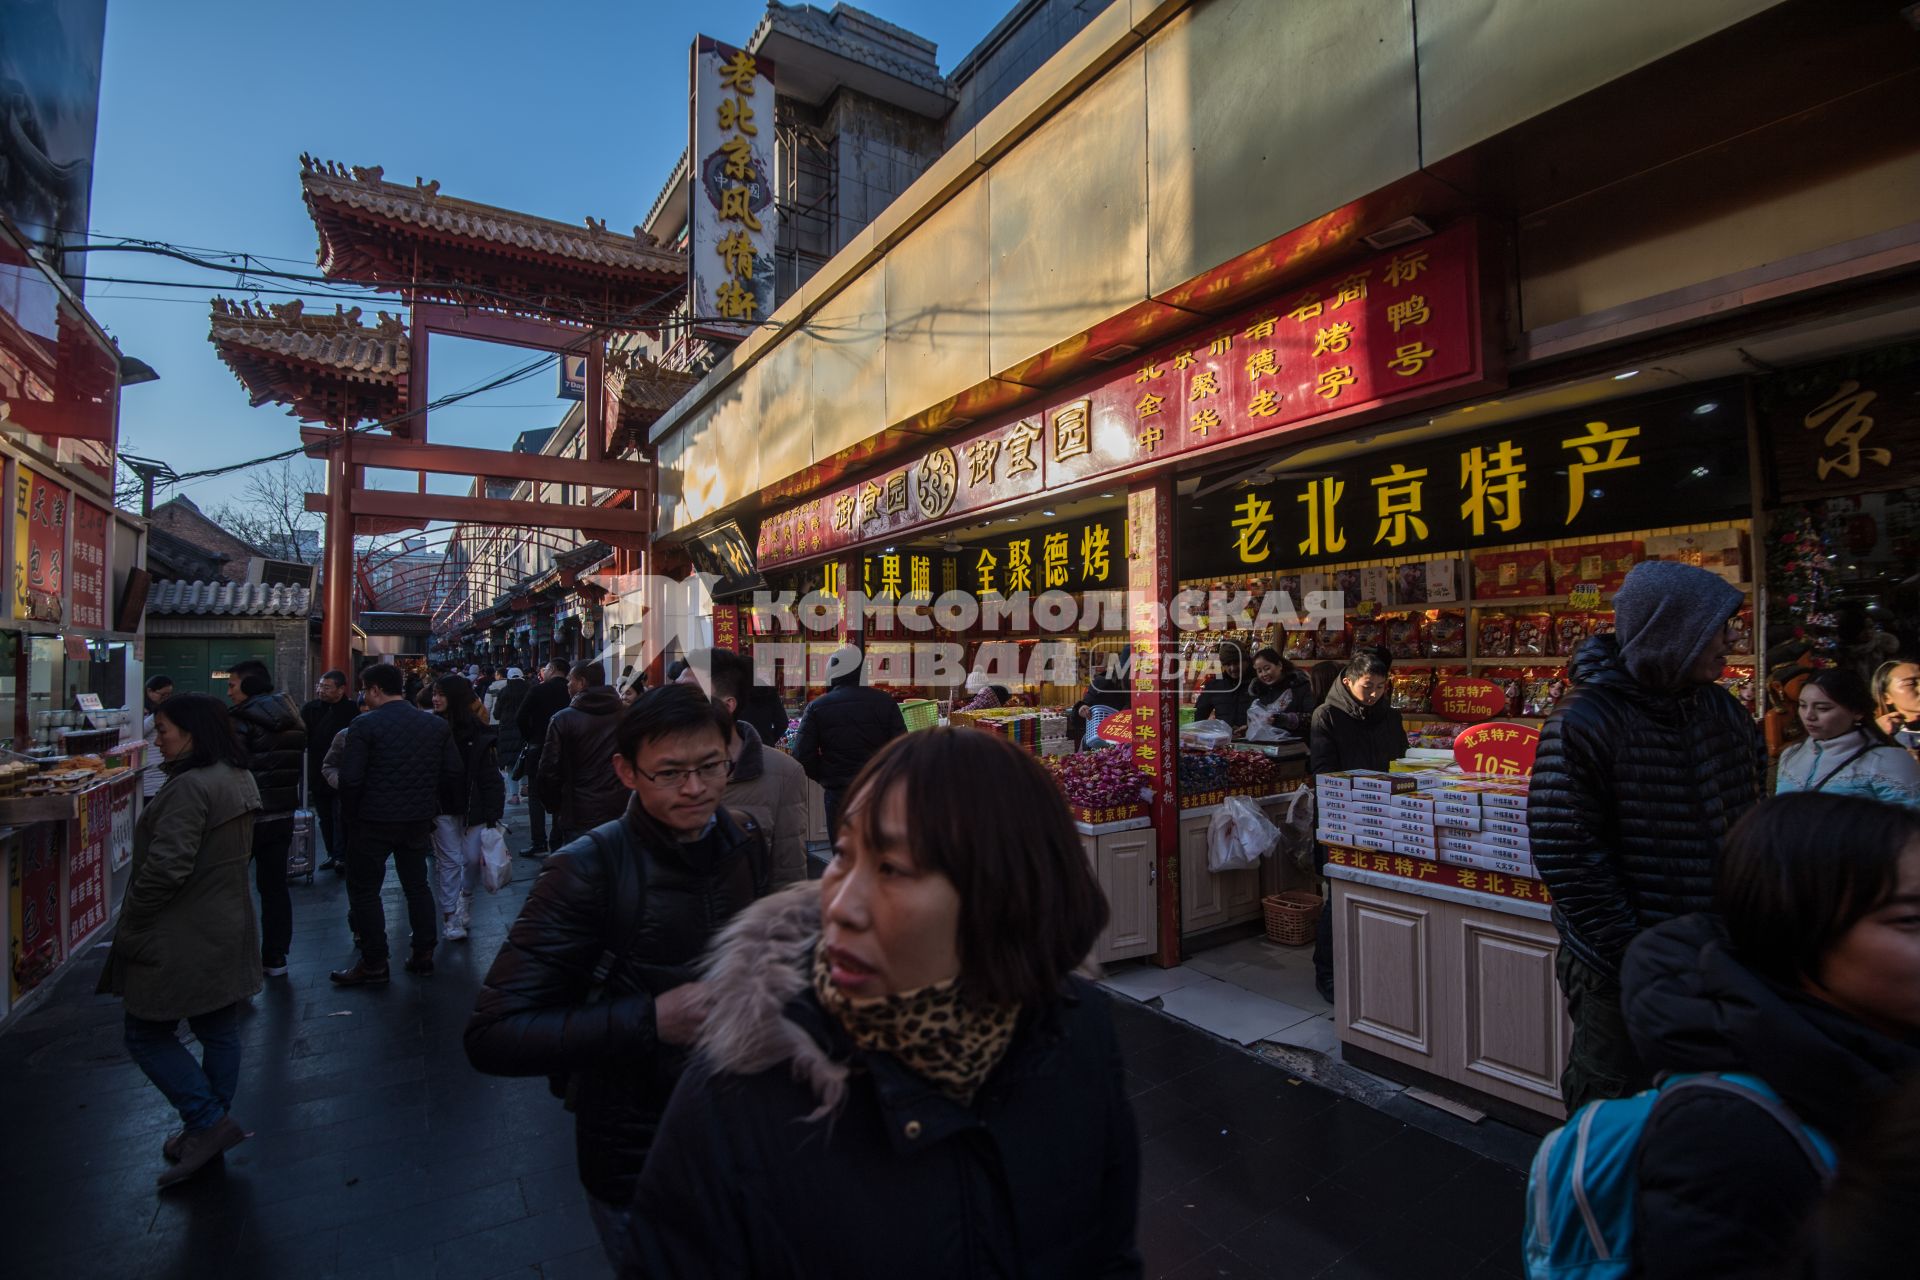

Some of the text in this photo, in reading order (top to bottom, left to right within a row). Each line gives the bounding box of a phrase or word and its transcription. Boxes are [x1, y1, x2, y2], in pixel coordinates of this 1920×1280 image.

[715, 51, 763, 327] 老北京风情街
[1136, 250, 1430, 384] 北京市著名商标
[1135, 294, 1432, 420] 全聚德烤鸭
[1138, 341, 1435, 453] 中华老字号
[1804, 379, 1892, 482] 京
[967, 399, 1093, 488] 御食园
[834, 469, 909, 531] 御食园
[1231, 421, 1642, 564] 老北京特产
[976, 522, 1129, 596] 全聚德烤
[716, 608, 735, 650] 北京烤
[1443, 685, 1493, 698] 北京特产
[1443, 700, 1492, 716] 15元/500g
[1464, 728, 1519, 749] 北京特产
[1081, 804, 1139, 823] 老北京特产
[1182, 791, 1225, 809] 老北京特产
[1329, 846, 1438, 879] 老北京特产
